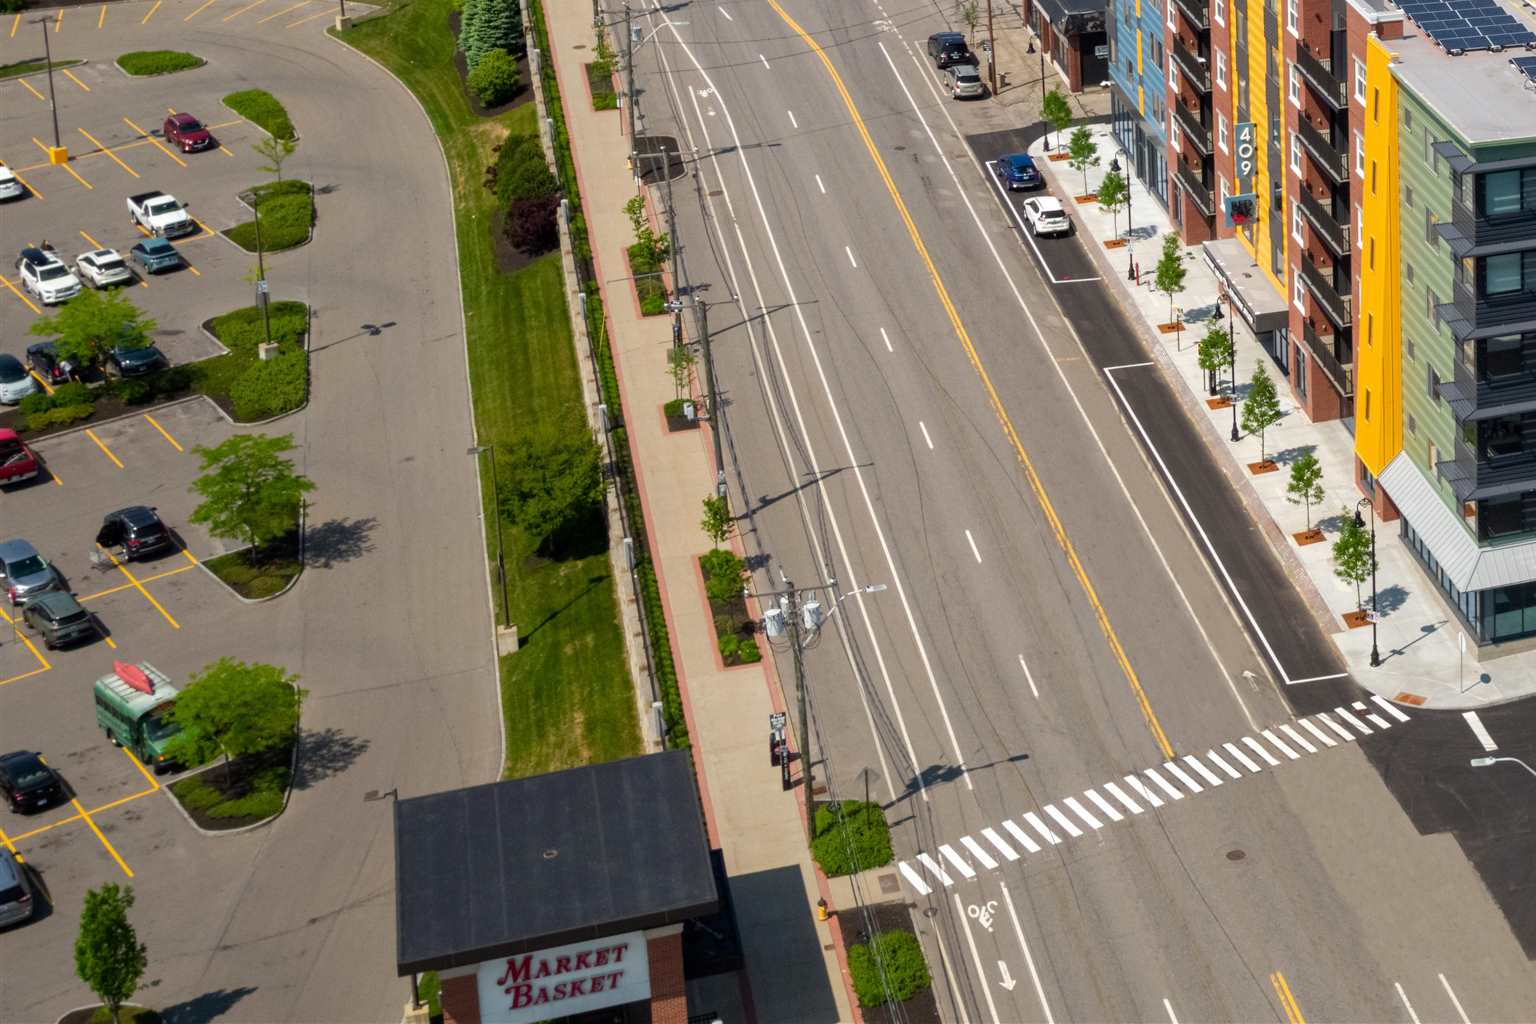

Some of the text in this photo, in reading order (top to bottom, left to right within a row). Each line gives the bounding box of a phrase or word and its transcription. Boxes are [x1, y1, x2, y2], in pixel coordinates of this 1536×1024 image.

[1239, 127, 1253, 175] 409
[497, 942, 629, 986] MARKET
[504, 970, 625, 1010] BASKET
